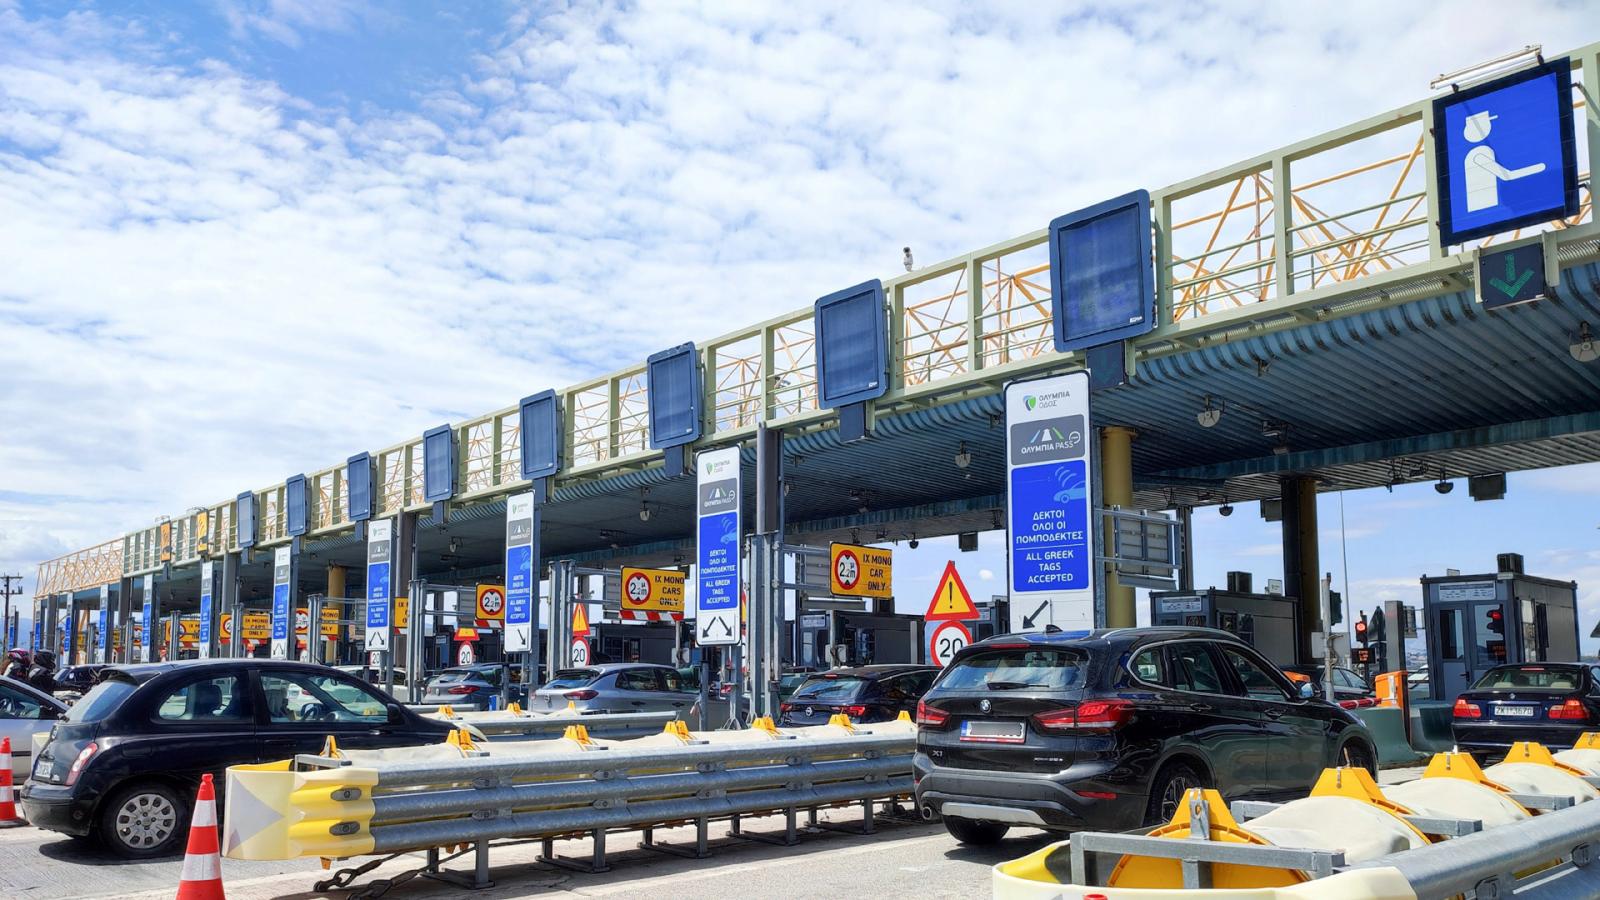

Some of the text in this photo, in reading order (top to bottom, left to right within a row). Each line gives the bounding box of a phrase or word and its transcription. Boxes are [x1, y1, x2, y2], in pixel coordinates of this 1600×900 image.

[1039, 391, 1070, 402] ΟΛΥΜΠΙΑ
[1039, 400, 1057, 409] ΟΔΟΣ
[1021, 441, 1074, 454] ΟΛΥΜΠΙΑ PASS
[1033, 509, 1065, 521] ΔΕΚΤΟΙ
[1032, 521, 1066, 532] ΟΛΟΙ ΟΙ
[1016, 531, 1083, 544] ΠΟΜΠΟΔΕΚΤΕΣ
[1026, 550, 1074, 561] ALL GREEK
[1039, 562, 1061, 572] TAGS
[870, 568, 884, 578] CAR
[1028, 573, 1073, 584] ACCEPTED
[662, 587, 681, 596] CARS
[868, 581, 886, 591] ONLY
[659, 597, 679, 607] ONLY
[706, 596, 731, 604] ACCEPTED
[939, 637, 963, 658] 20
[461, 651, 471, 663] 20
[573, 648, 586, 663] 20
[932, 750, 943, 758] X1
